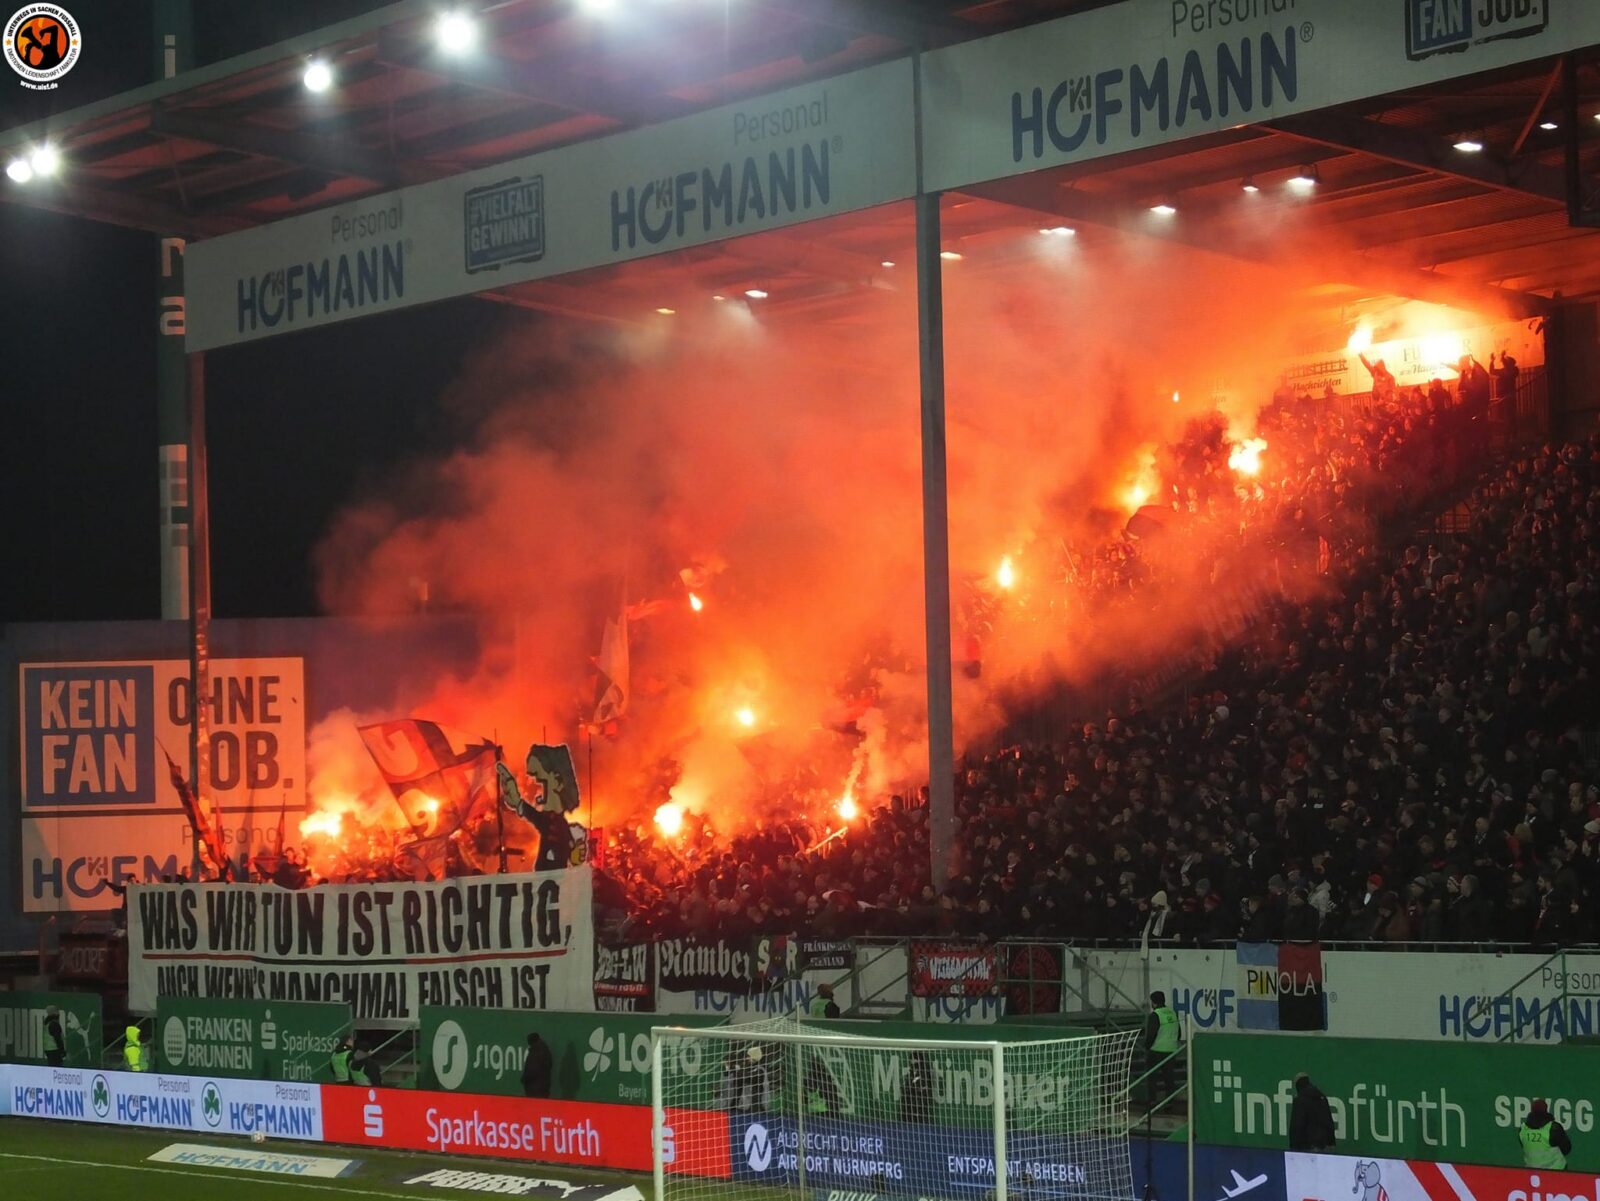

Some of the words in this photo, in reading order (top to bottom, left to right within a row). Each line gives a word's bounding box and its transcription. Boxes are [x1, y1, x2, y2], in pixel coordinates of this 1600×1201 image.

[1172, 0, 1295, 38] Persona
[1420, 0, 1464, 41] FAN
[1011, 25, 1298, 163] HOFMANN
[733, 92, 829, 146] Personal
[610, 138, 831, 252] HOFMANN
[331, 197, 404, 245] Personal
[471, 212, 539, 253] GEWINNT
[237, 238, 405, 334] HOFMANN
[40, 679, 136, 729] KEIN
[41, 733, 137, 795] FAN
[205, 730, 294, 791] OB.
[139, 889, 198, 950] WAS
[205, 890, 257, 951] WIR
[261, 892, 325, 955] TUN
[336, 890, 394, 956] IST
[402, 879, 572, 955] RICHTIG,
[270, 971, 410, 1019] MANCHMAL
[417, 966, 503, 1008] FALSCH
[511, 964, 550, 1009] IST
[1247, 970, 1317, 997] PINOLA
[186, 1016, 253, 1042] FRANKEN
[1439, 994, 1600, 1040] HOFMAN
[186, 1043, 253, 1070] BRUNNEN
[281, 1029, 341, 1056] Sparkasse
[618, 1032, 701, 1076] LOTO
[53, 1070, 83, 1086] Personal
[282, 1059, 312, 1081] Fürth
[473, 1043, 530, 1081] signi
[15, 1085, 85, 1117] HOFMANN
[158, 1077, 190, 1094] Personal
[275, 1083, 311, 1101] Personal
[117, 1093, 192, 1127] HOFMANN
[229, 1101, 313, 1136] HOFMANN
[1494, 1094, 1594, 1133] SPGG
[426, 1107, 534, 1152] Sparkasse
[540, 1117, 600, 1158] Fürth
[777, 1131, 837, 1151] ALBRECHT
[170, 1151, 308, 1174] HOFMANN
[777, 1153, 830, 1174] AIRORT
[948, 1155, 1022, 1178] ENTSPANT
